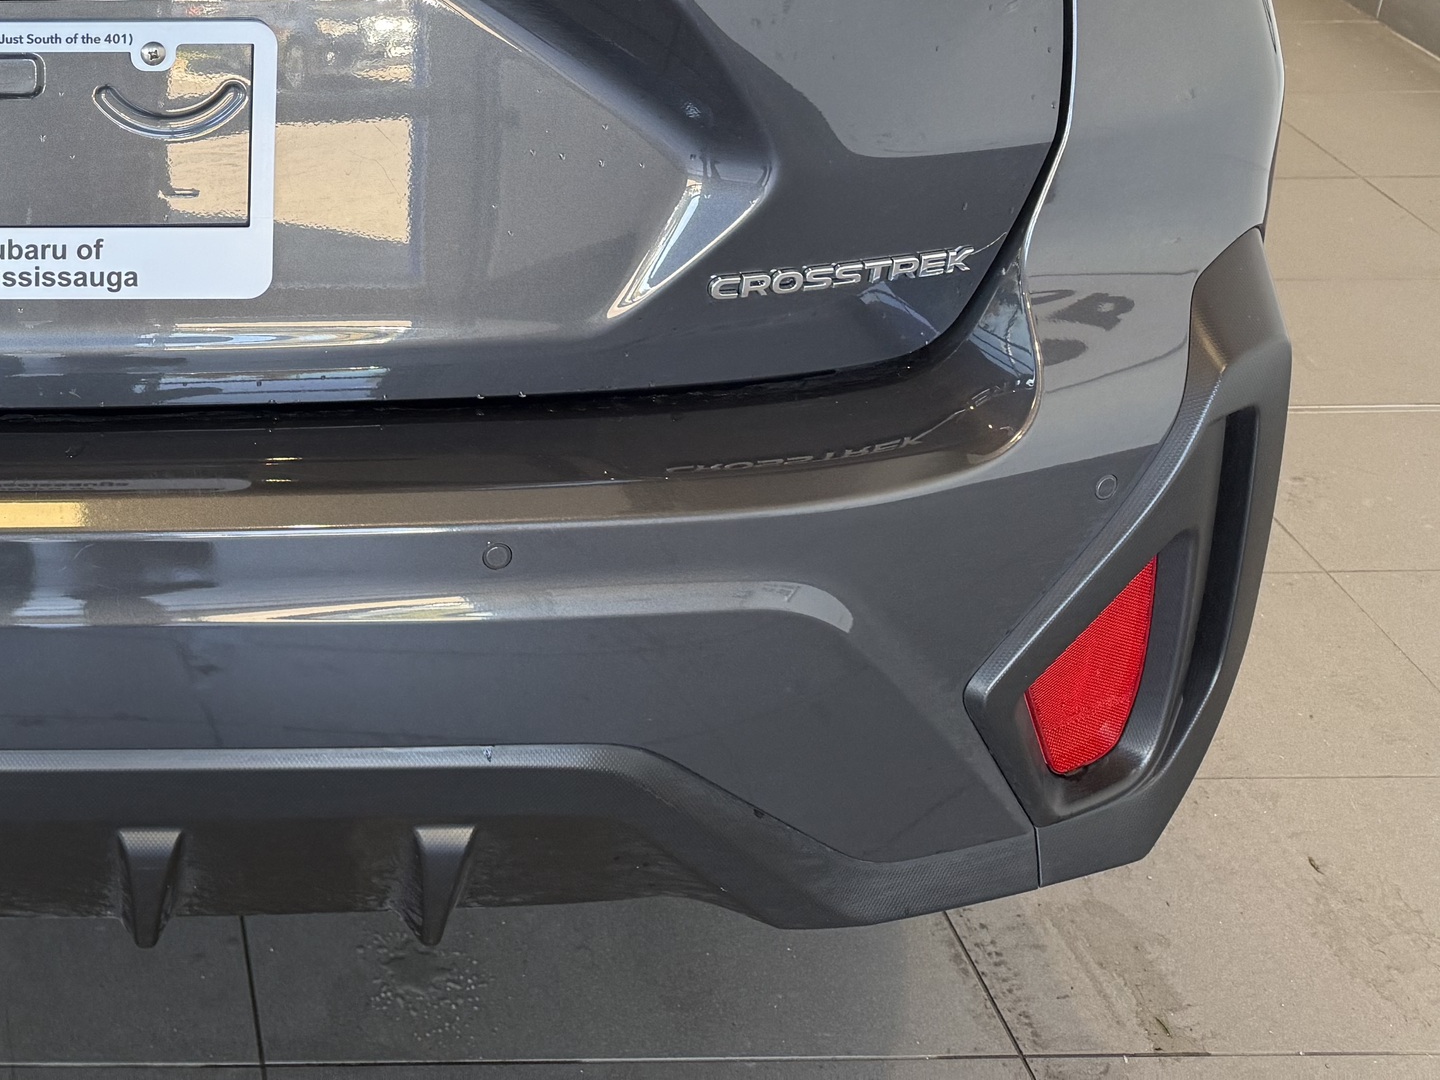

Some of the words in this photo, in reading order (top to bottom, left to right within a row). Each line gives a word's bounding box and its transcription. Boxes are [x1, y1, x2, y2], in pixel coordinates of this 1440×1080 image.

[26, 33, 62, 45] South
[65, 33, 79, 45] of
[81, 33, 102, 45] the
[104, 33, 134, 46] 401)
[76, 238, 104, 260] of
[707, 245, 975, 300] CROSSTREK
